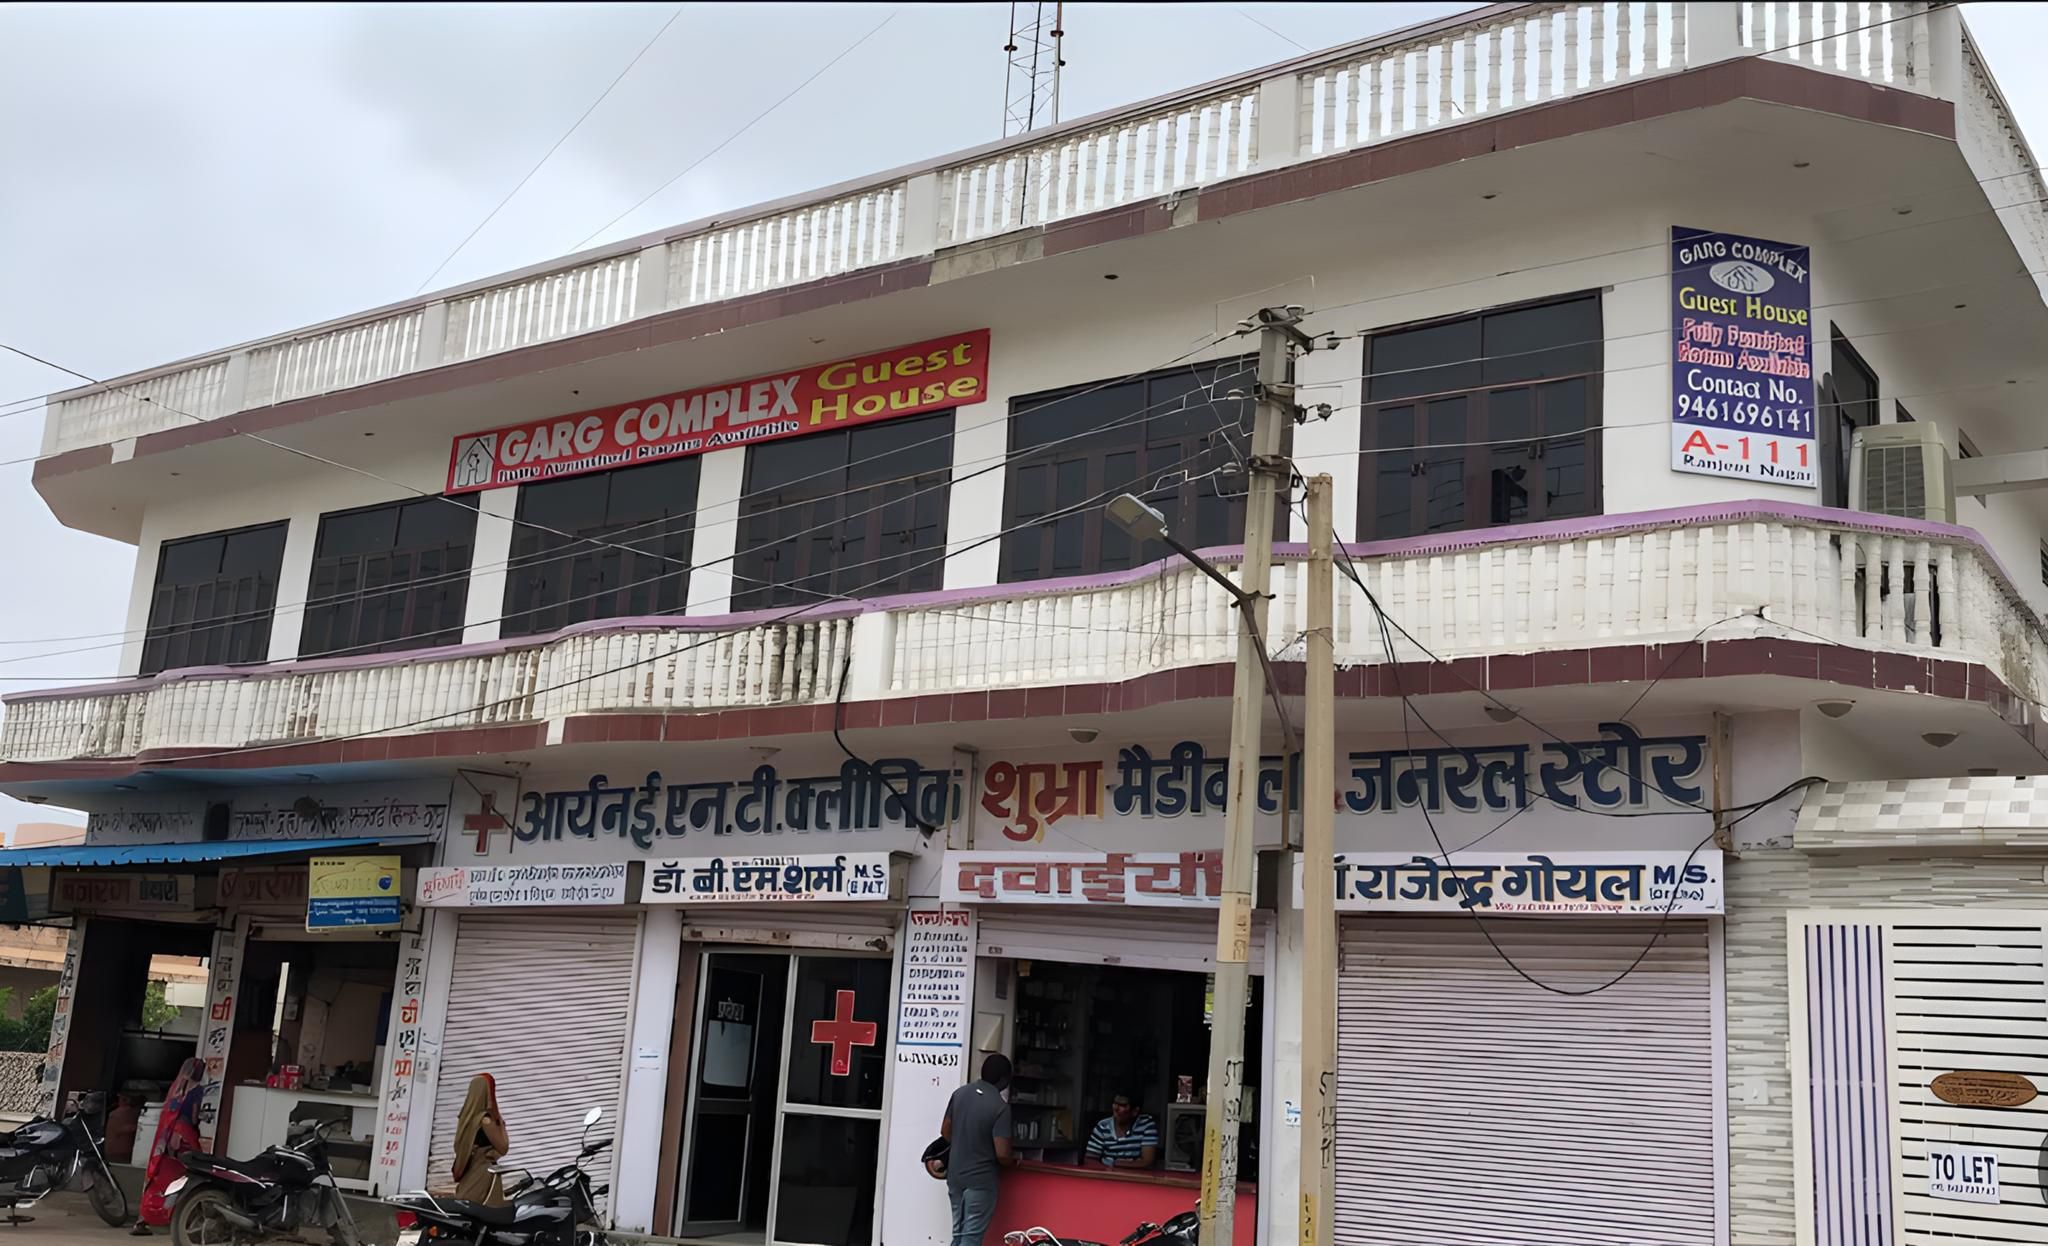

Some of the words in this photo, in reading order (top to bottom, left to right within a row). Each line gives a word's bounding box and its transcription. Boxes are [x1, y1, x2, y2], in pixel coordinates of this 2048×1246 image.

[1680, 241, 1726, 264] GARG
[1732, 241, 1807, 284] COMPLEX
[1679, 287, 1738, 316] Guest
[1746, 296, 1807, 326] House
[817, 343, 972, 391] Guest
[1688, 369, 1761, 399] Contact
[1769, 378, 1803, 405] No.
[501, 416, 603, 466] GARG
[614, 375, 800, 446] COMPLEX
[809, 376, 978, 425] House
[1678, 394, 1810, 433] 9461696141
[1345, 744, 1532, 813] जनरल
[1540, 721, 1708, 811] स्टोर
[1502, 855, 1646, 903] गोयल
[1931, 1153, 1954, 1180] TO
[1962, 1155, 1995, 1184] LET
